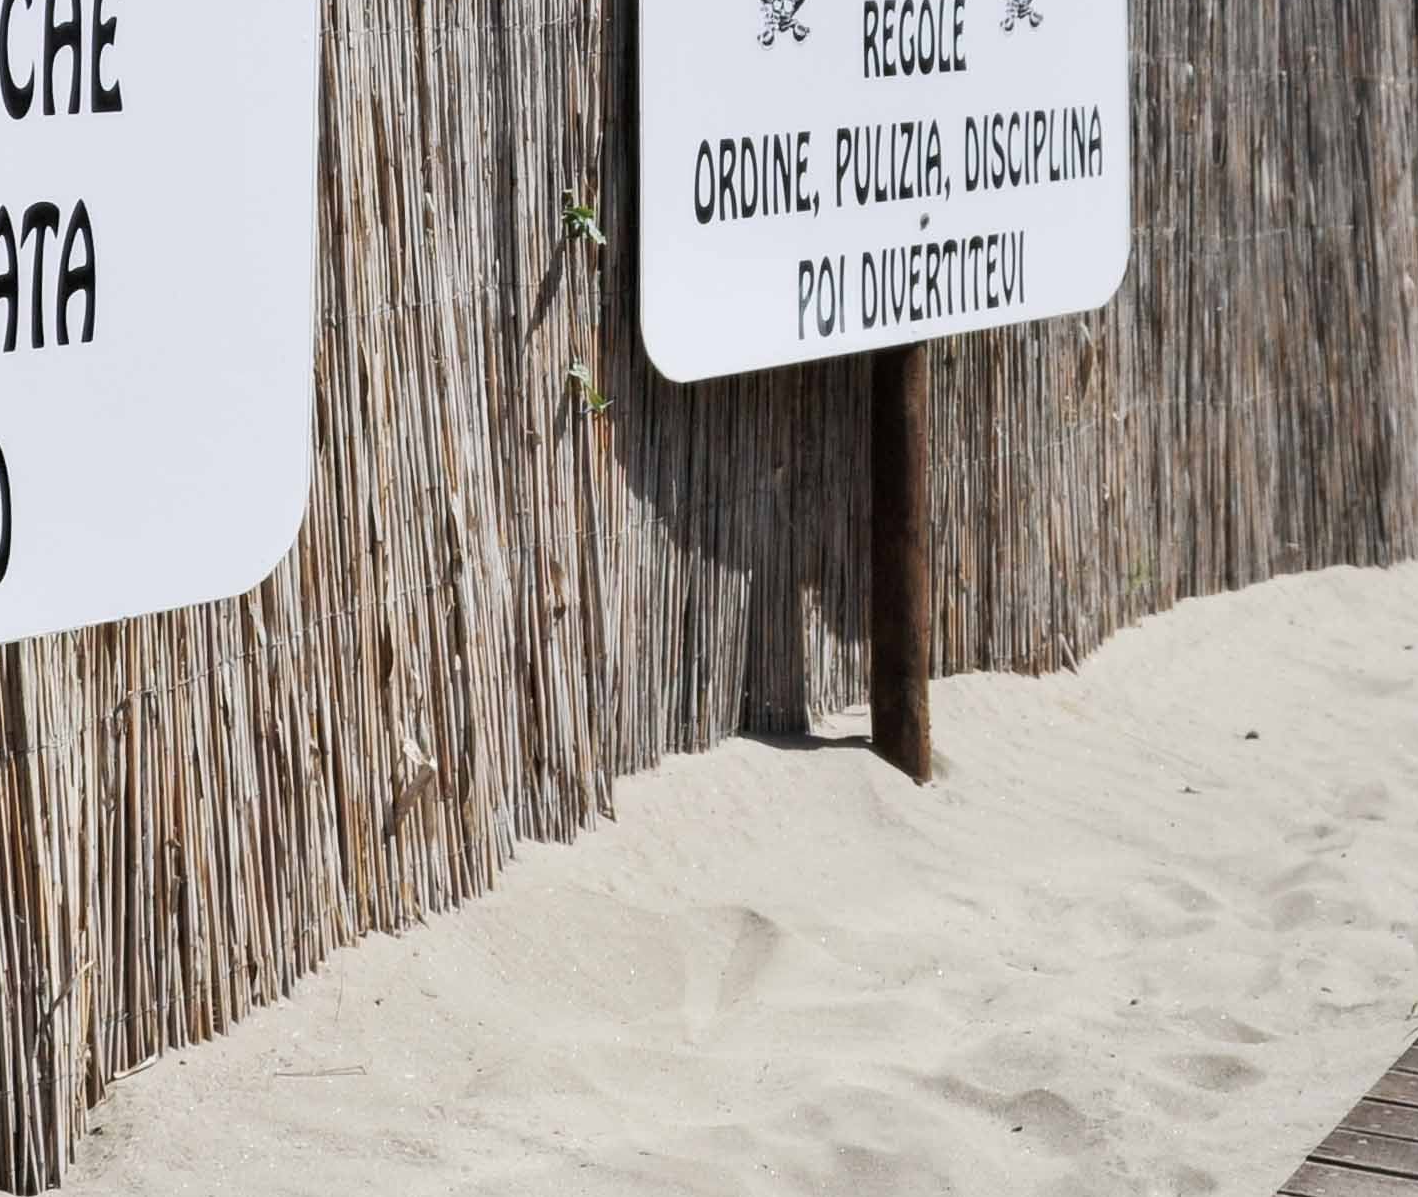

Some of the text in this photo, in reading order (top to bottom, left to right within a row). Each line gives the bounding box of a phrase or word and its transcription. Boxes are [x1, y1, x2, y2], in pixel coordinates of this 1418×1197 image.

[693, 105, 1103, 226] ORDINE, PULIZIA, DISCIPLINA
[797, 230, 1026, 342] POI DIVERTITEVI
